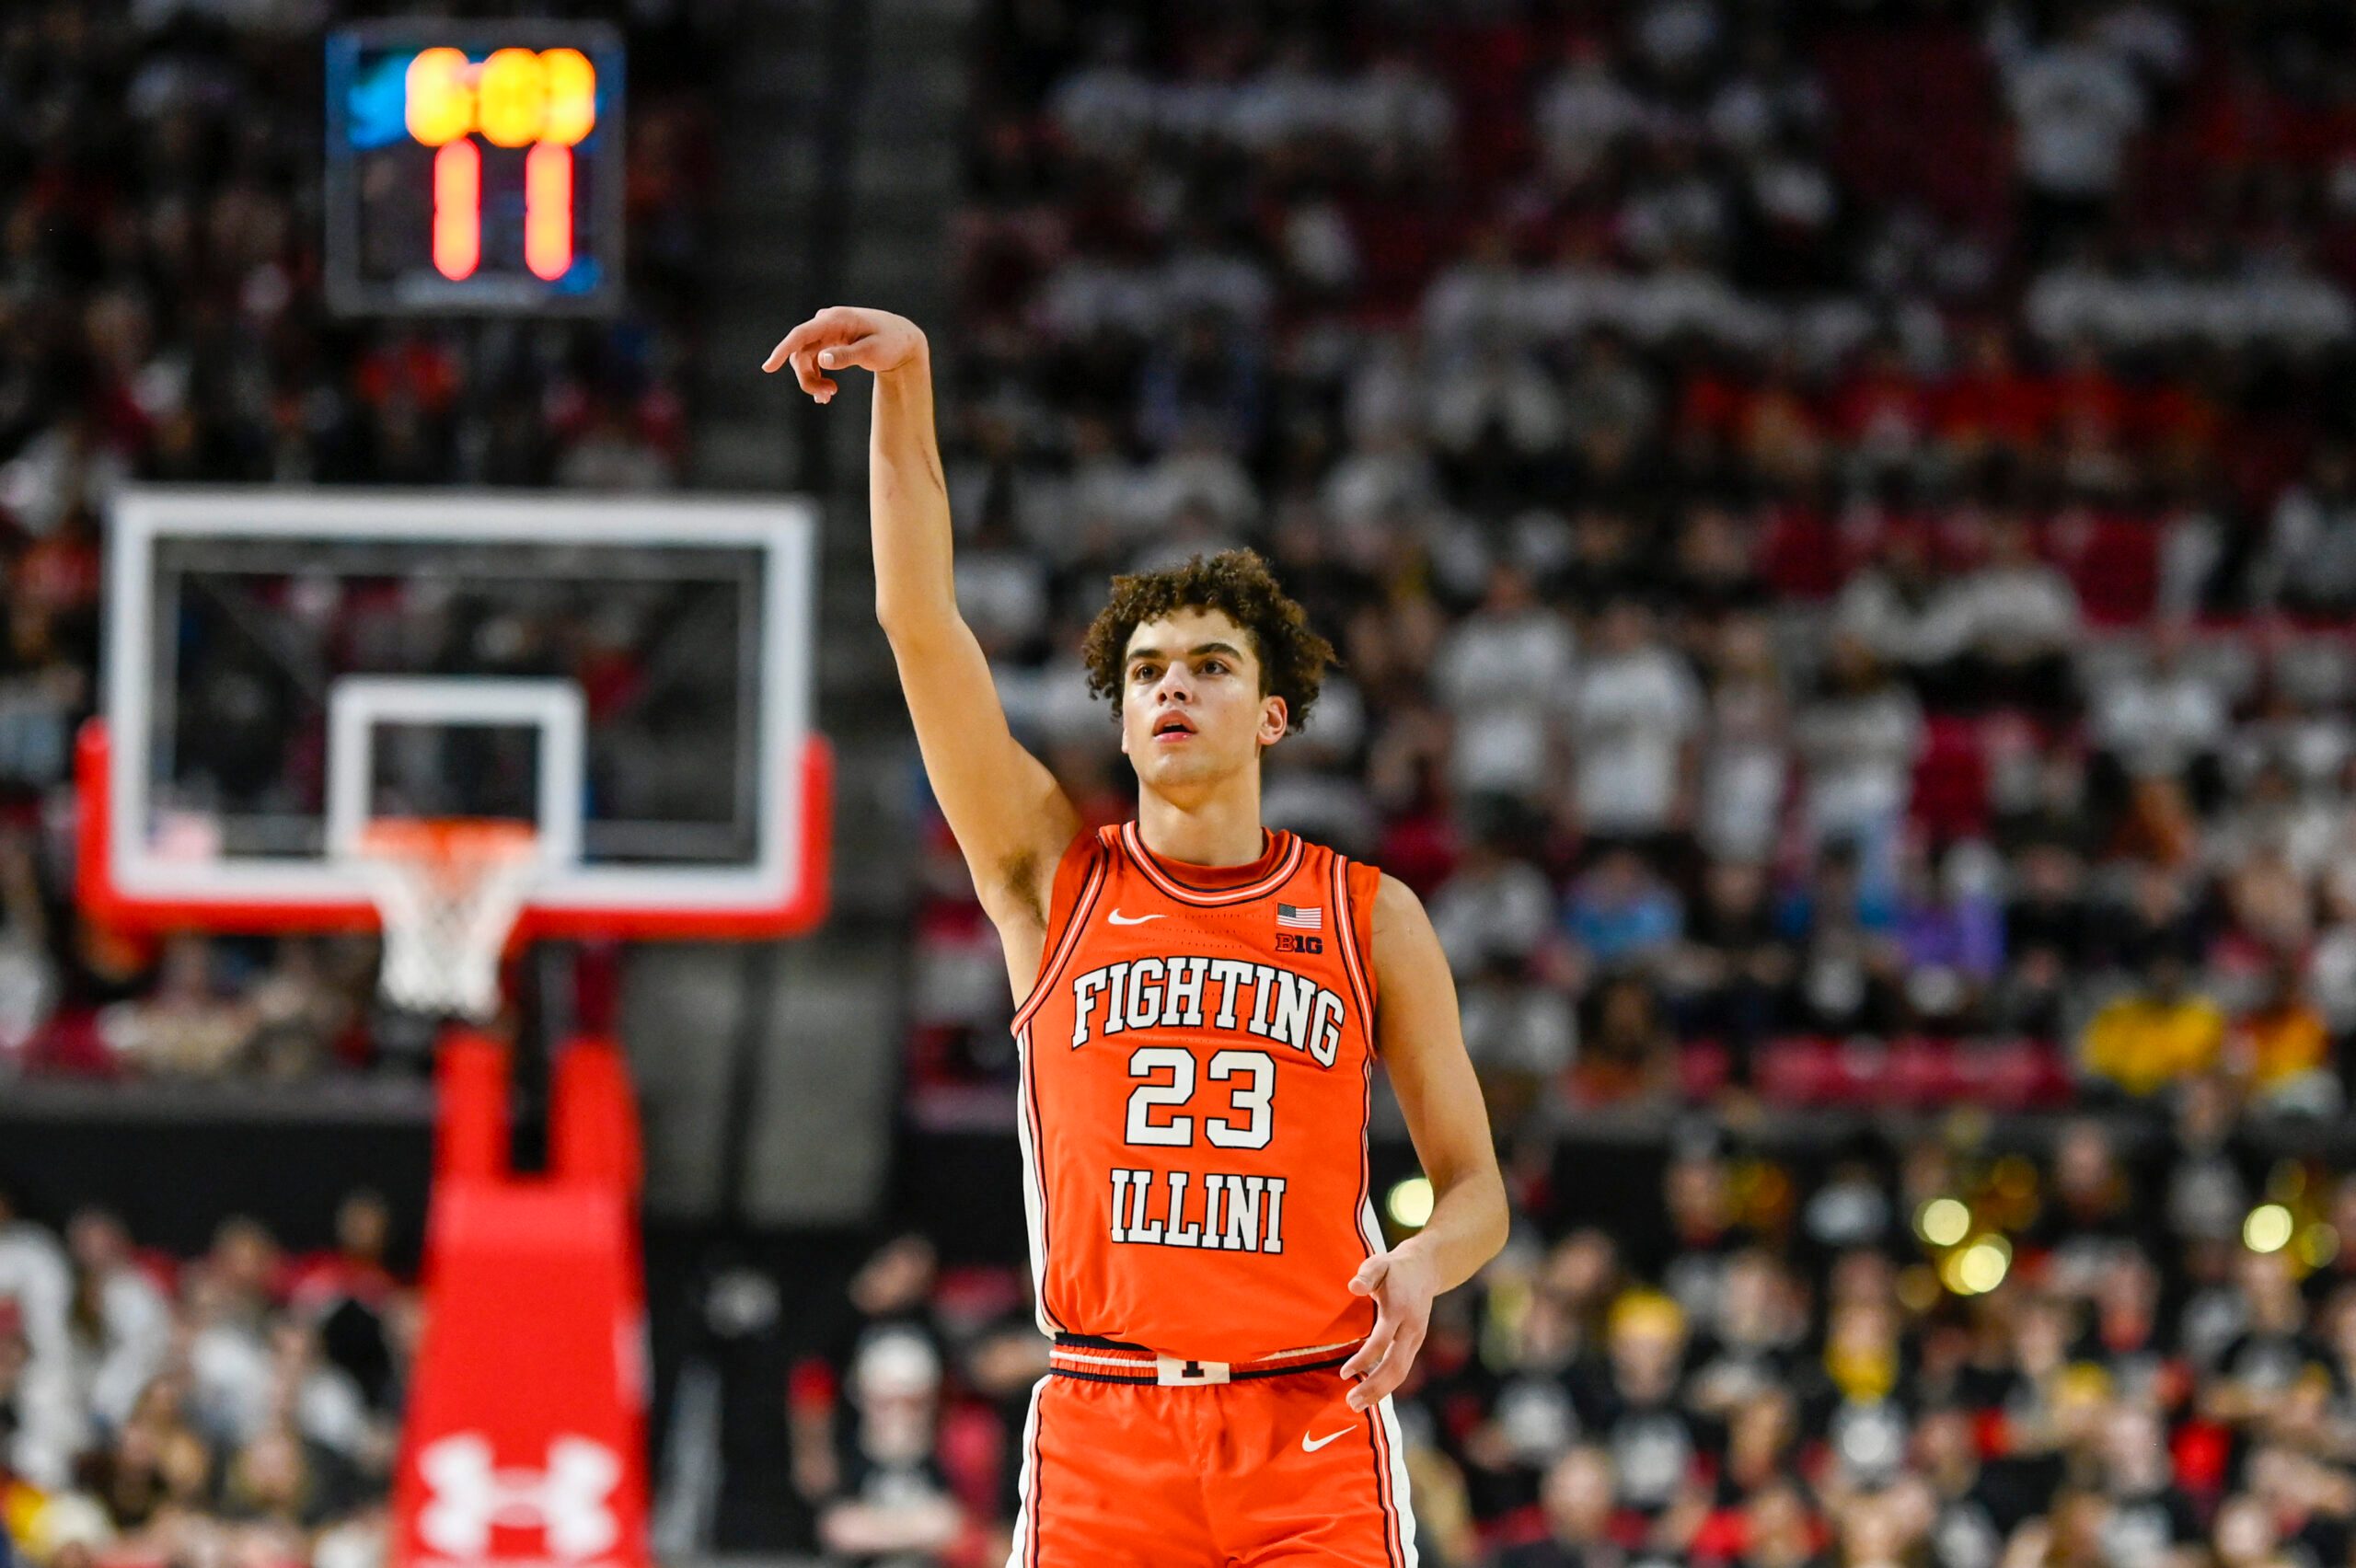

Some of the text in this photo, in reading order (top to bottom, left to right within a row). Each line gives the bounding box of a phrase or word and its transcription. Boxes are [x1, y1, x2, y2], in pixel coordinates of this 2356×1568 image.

[1071, 957, 1345, 1068] FIGHTING
[1125, 1047, 1276, 1149] 23
[1110, 1169, 1286, 1254] ILLINI
